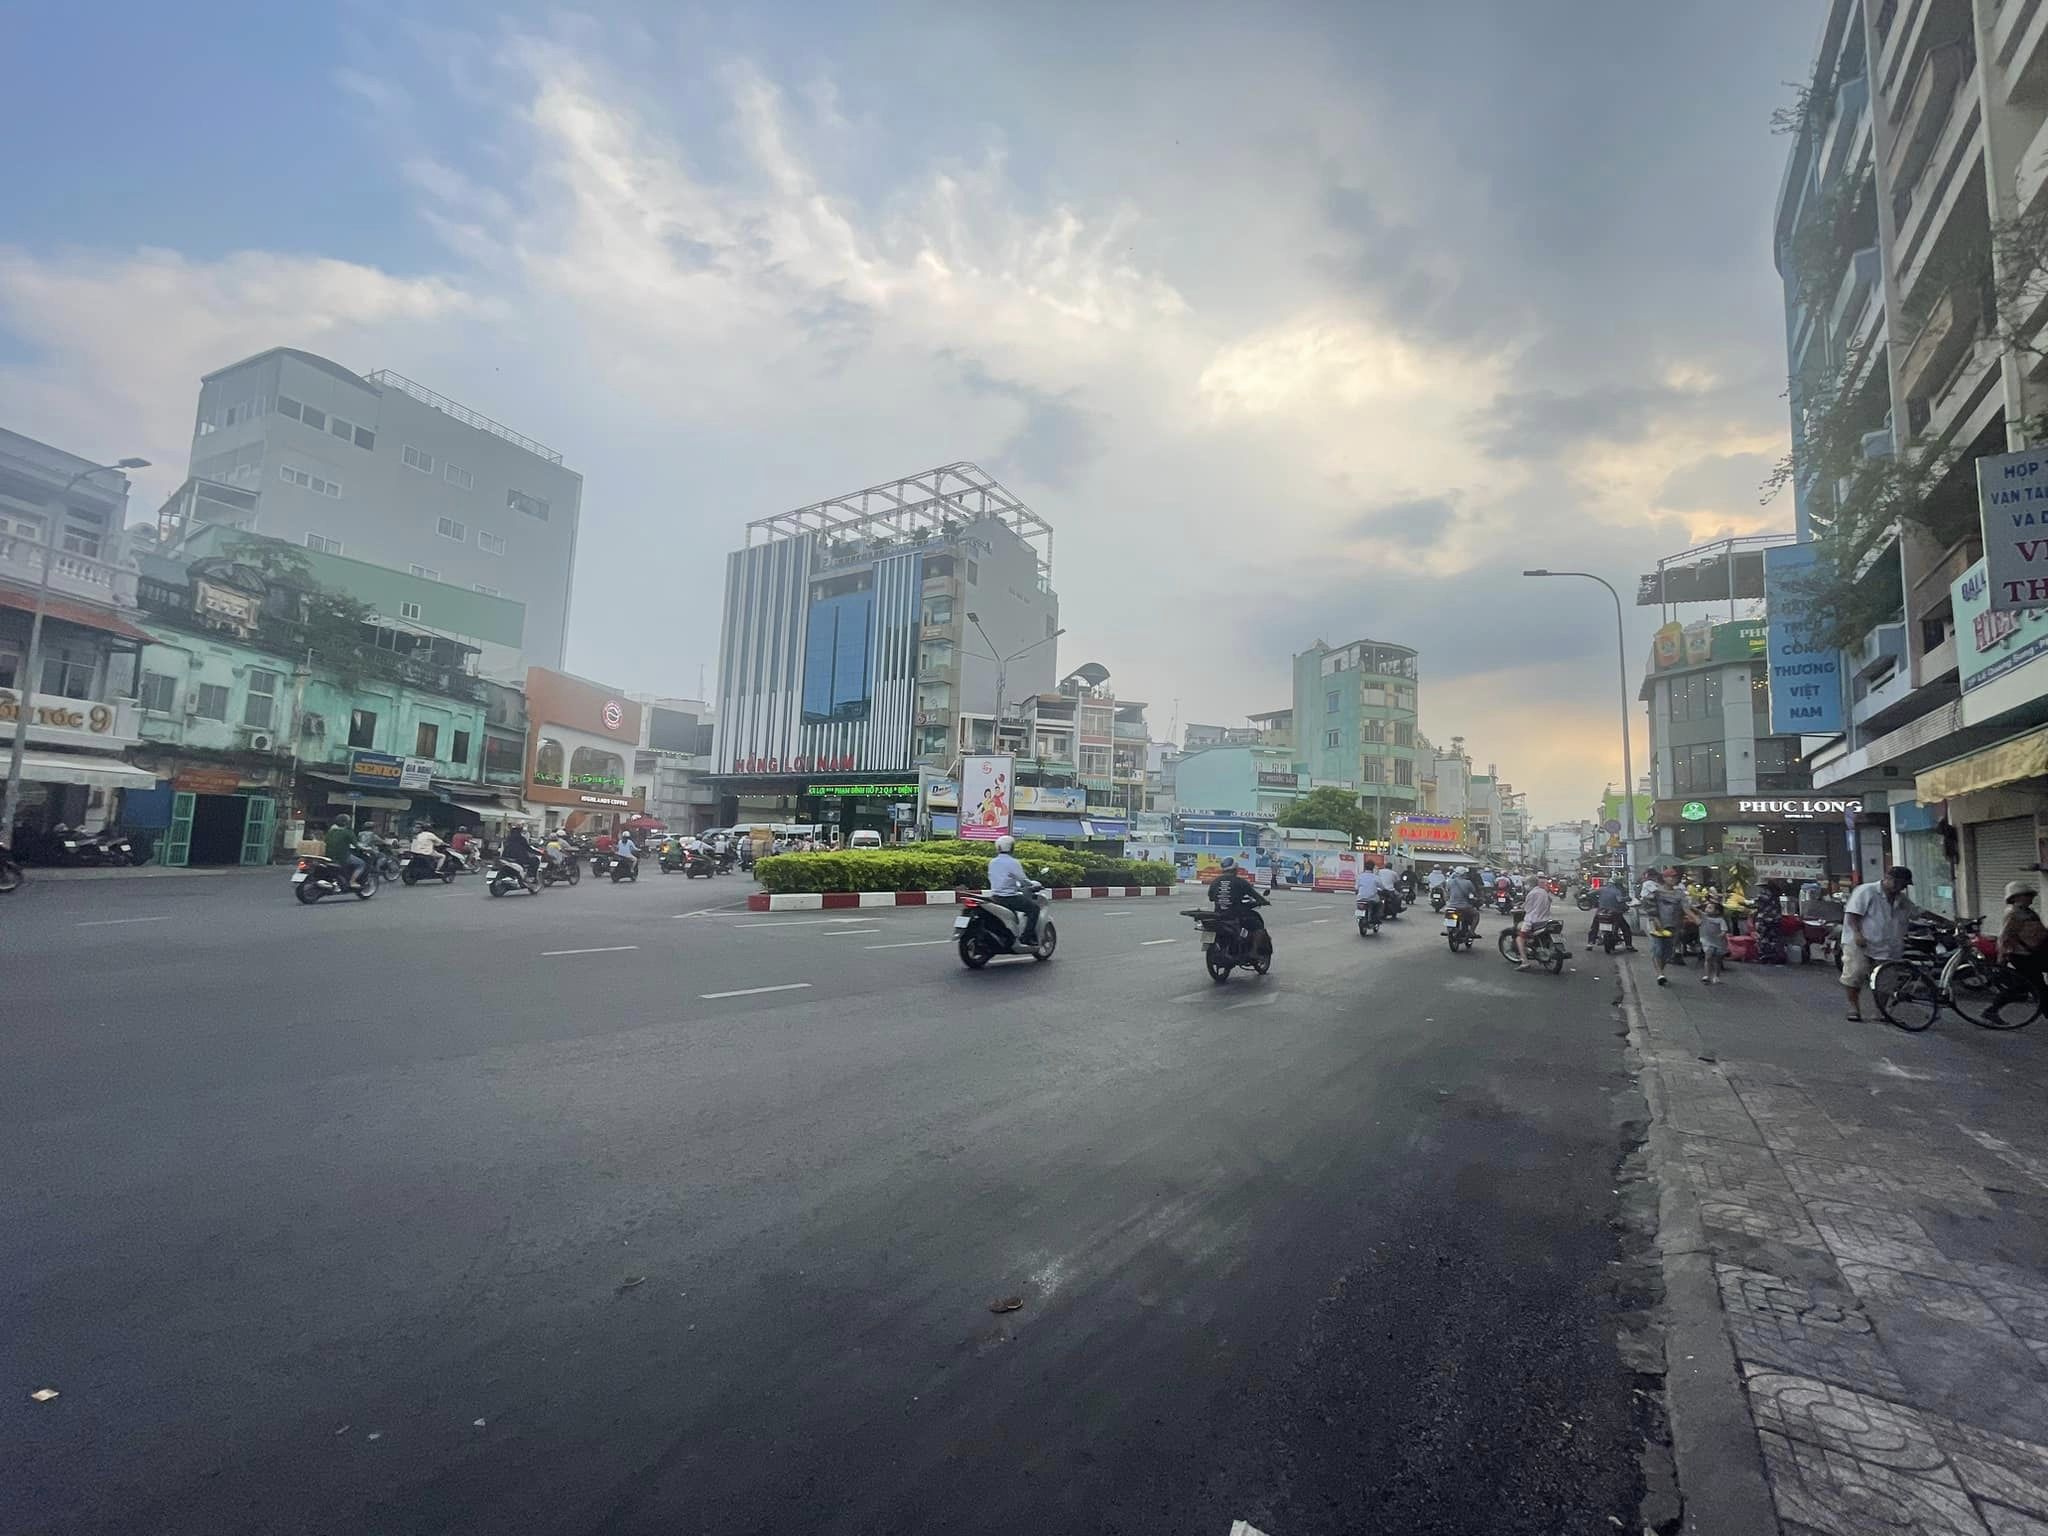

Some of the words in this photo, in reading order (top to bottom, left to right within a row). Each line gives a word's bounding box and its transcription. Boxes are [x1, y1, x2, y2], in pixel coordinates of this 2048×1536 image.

[1774, 661, 1836, 677] THƯƠNG
[1790, 682, 1821, 701] VIỆT
[90, 704, 112, 734] 9
[1790, 706, 1823, 720] NAM
[581, 795, 610, 804] HIGHLANDS
[1801, 800, 1864, 813] LONG
